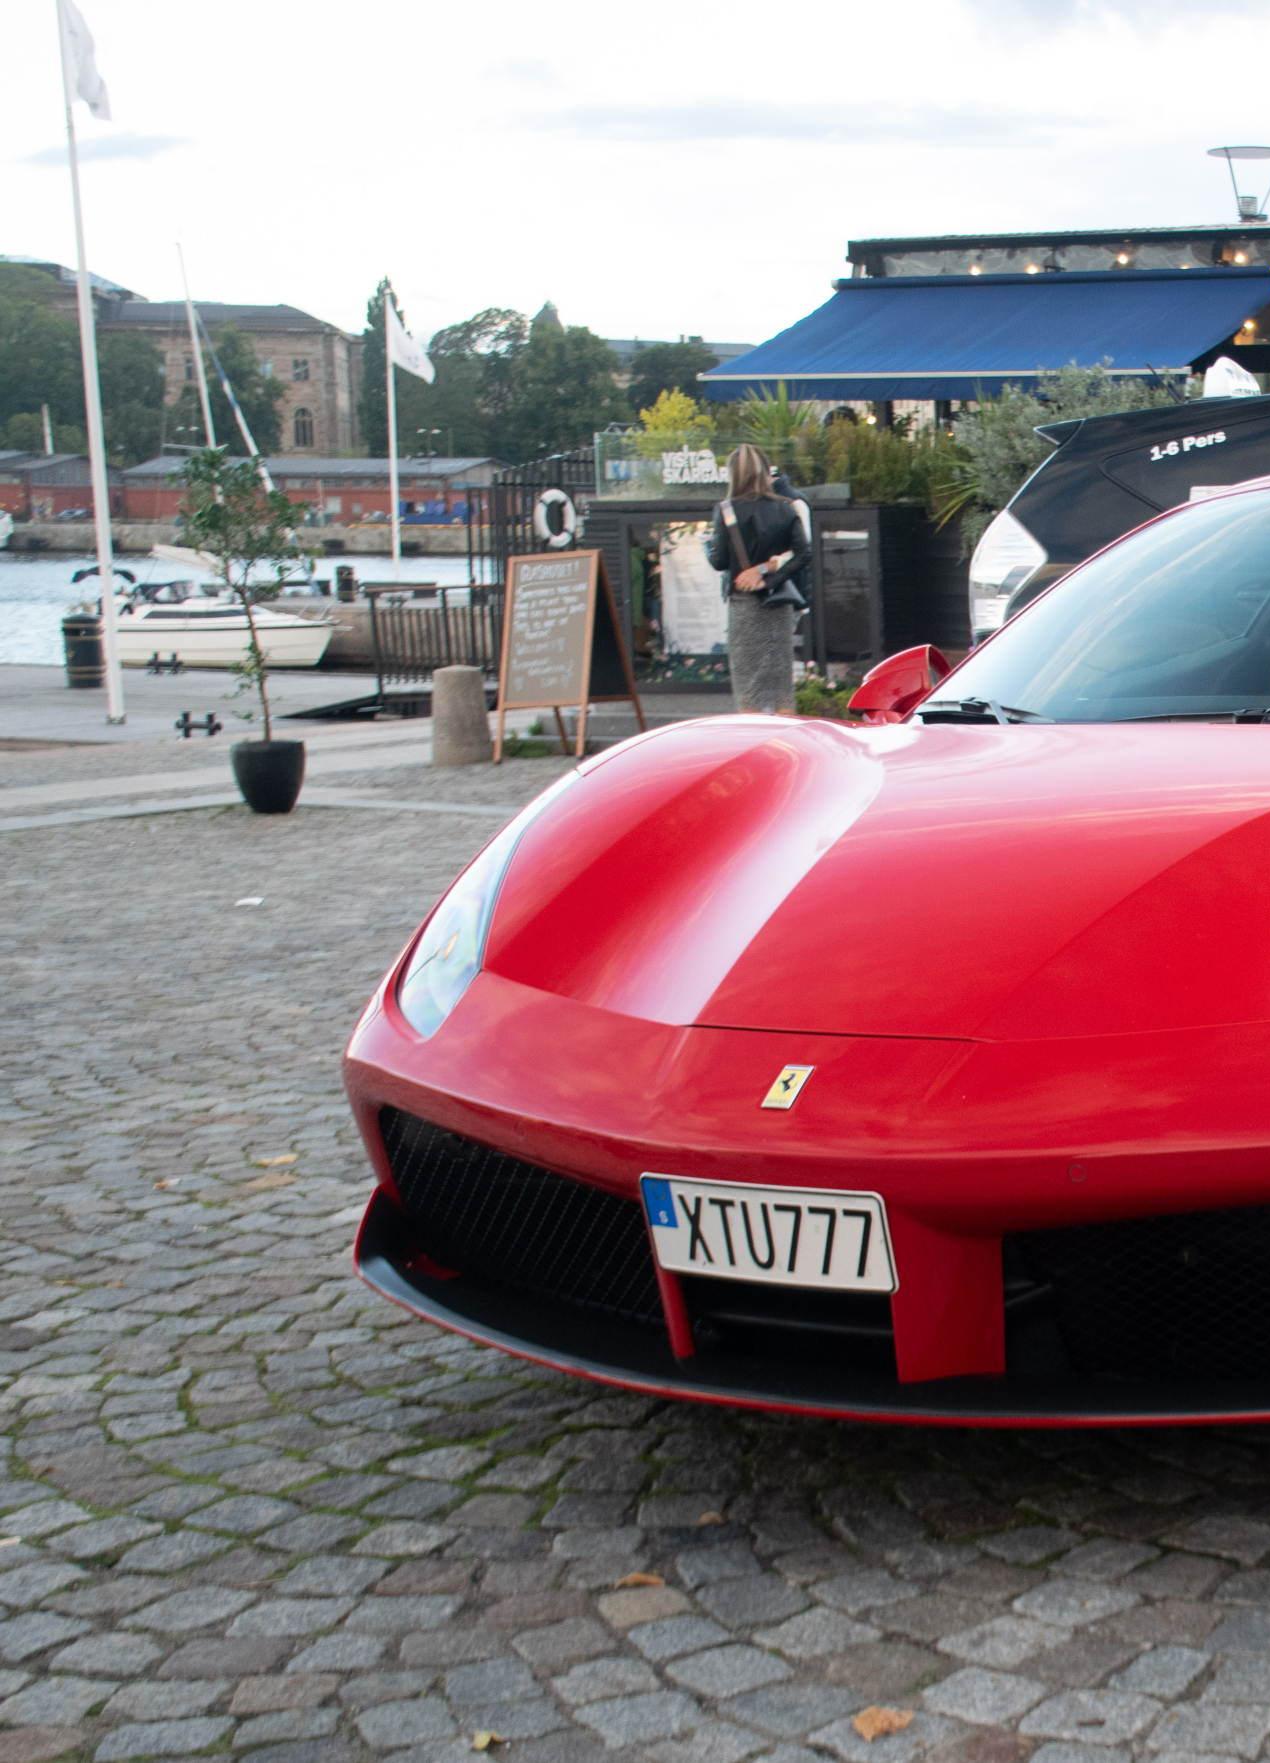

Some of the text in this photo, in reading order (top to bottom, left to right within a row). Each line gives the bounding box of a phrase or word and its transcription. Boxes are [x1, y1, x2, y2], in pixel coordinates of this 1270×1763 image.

[661, 444, 697, 467] VISIT
[1150, 431, 1227, 461] 1-6 Pers
[677, 1193, 873, 1277] XTU777
